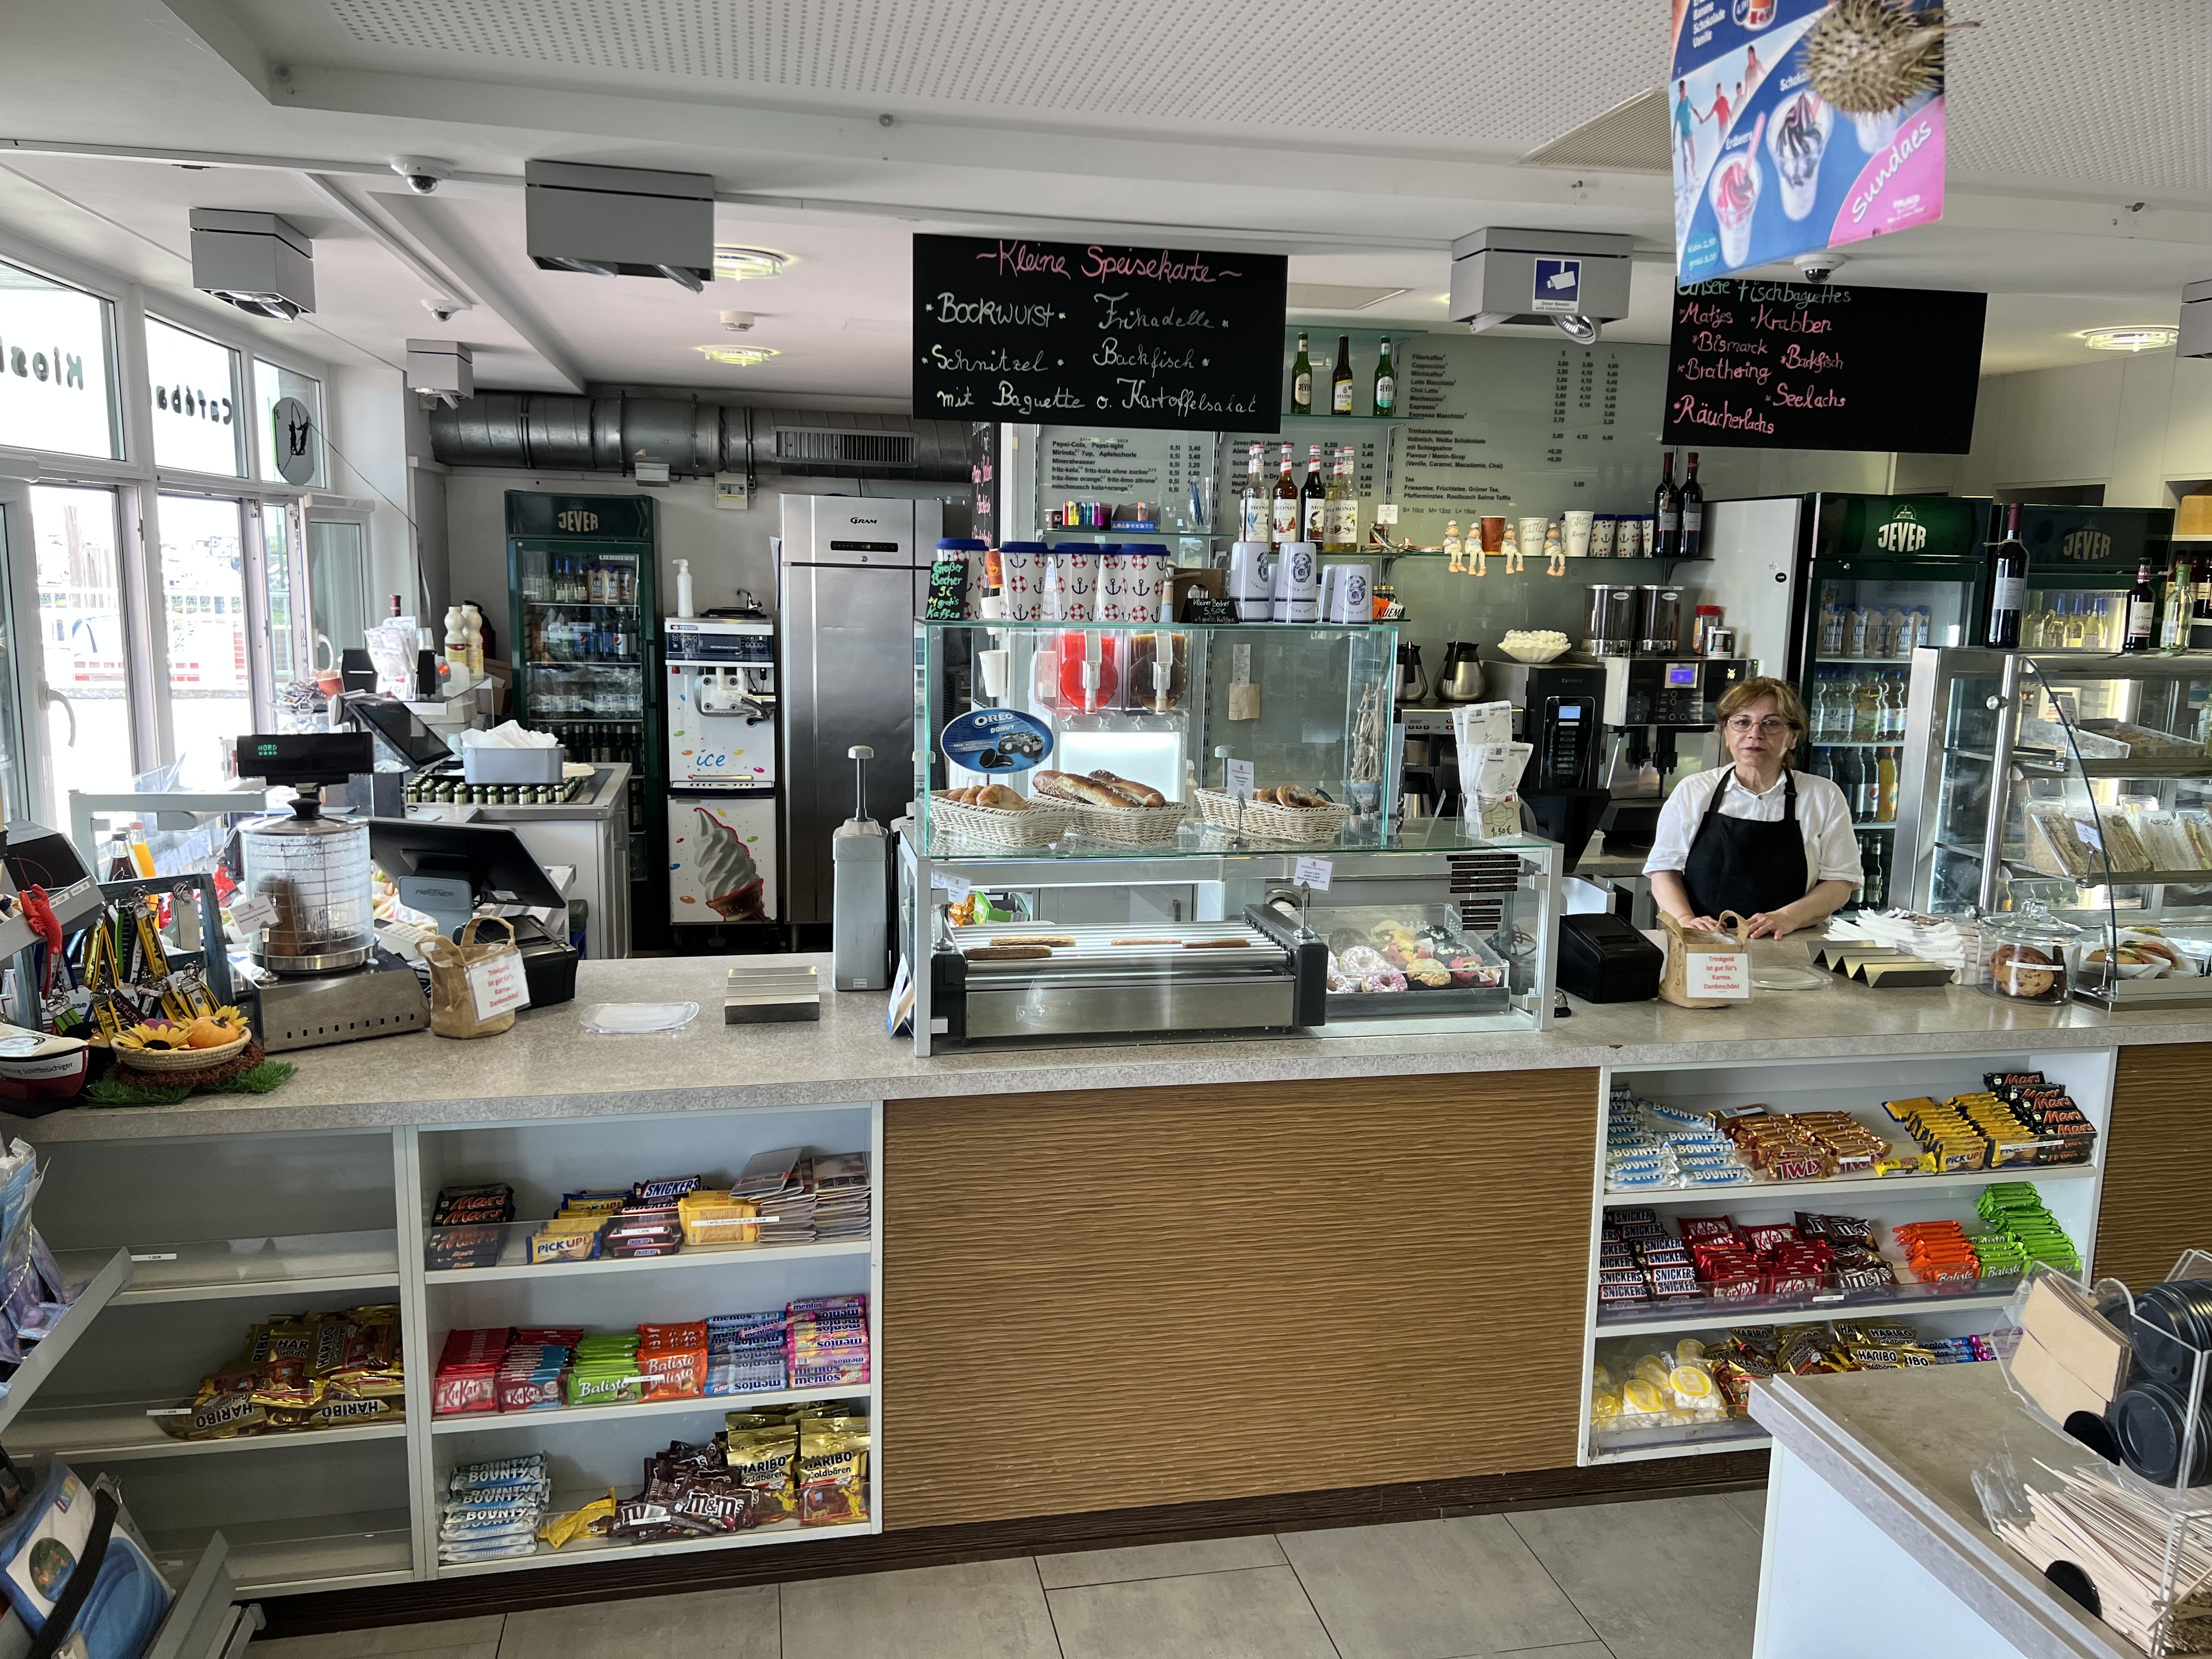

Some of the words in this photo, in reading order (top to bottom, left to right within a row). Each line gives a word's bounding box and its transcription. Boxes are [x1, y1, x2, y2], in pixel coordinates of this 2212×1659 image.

[1725, 131, 1753, 150] Erdbeere
[1852, 121, 1932, 223] Sundaes
[998, 239, 1071, 280] Kleine
[1081, 245, 1216, 284] Speisekarte
[1094, 292, 1214, 330] Frikadelle
[932, 344, 1049, 371] Schnitzel
[1093, 337, 1195, 377] Backfisch
[937, 388, 975, 407] mit
[992, 381, 1085, 414] Baguette
[1117, 378, 1256, 417] Kartoffelsalat
[558, 511, 598, 532] JEVER
[1877, 522, 1927, 552] JEVER
[2062, 531, 2112, 560] JEVER
[933, 561, 963, 574] Großer
[931, 573, 962, 586] Becher
[1211, 599, 1230, 607] Becher
[926, 605, 960, 619] Kaffee
[974, 713, 1015, 727] OREO
[990, 725, 1015, 733] DONUT
[696, 749, 726, 768] ice
[1491, 825, 1512, 837] 1,50€
[2004, 1074, 2040, 1086] Mars
[2034, 1098, 2072, 1110] Mars
[1653, 1103, 1703, 1122] BOUNTY
[2043, 1110, 2083, 1124] Mars
[1669, 1132, 1716, 1141] BOUNTY
[2058, 1124, 2094, 1136] Mars
[1677, 1144, 1723, 1153] BOUNTY
[1681, 1156, 1728, 1165] BOUNTY
[1967, 1152, 1982, 1160] UP!
[1694, 1169, 1741, 1180] BOUNTY
[646, 1177, 699, 1197] SNICKERS
[450, 1195, 505, 1211] Mars
[443, 1209, 503, 1225] Mars
[566, 1236, 587, 1249] UP!
[1757, 1230, 1782, 1250] KitKat
[1600, 1272, 1641, 1283] SNICKERS
[1656, 1268, 1695, 1280] SNICKERS
[1938, 1271, 1973, 1286] Balisto
[1603, 1286, 1646, 1297] SNICKERS
[794, 1302, 822, 1311] mentos
[1870, 1329, 1911, 1338] HARIBO
[316, 1326, 335, 1368] HARIBO
[817, 1338, 862, 1348] mentos
[1858, 1350, 1898, 1362] HARIBO
[647, 1356, 695, 1375] Balisto
[735, 1379, 781, 1390] mentos
[795, 1374, 840, 1384] mentos
[442, 1381, 480, 1408] KitKat
[507, 1387, 540, 1405] KitKat
[195, 1402, 252, 1427] HARIBO
[321, 1401, 377, 1418] HARIBO
[469, 1468, 528, 1482] BOUNTY
[466, 1508, 527, 1521] BOUNTY
